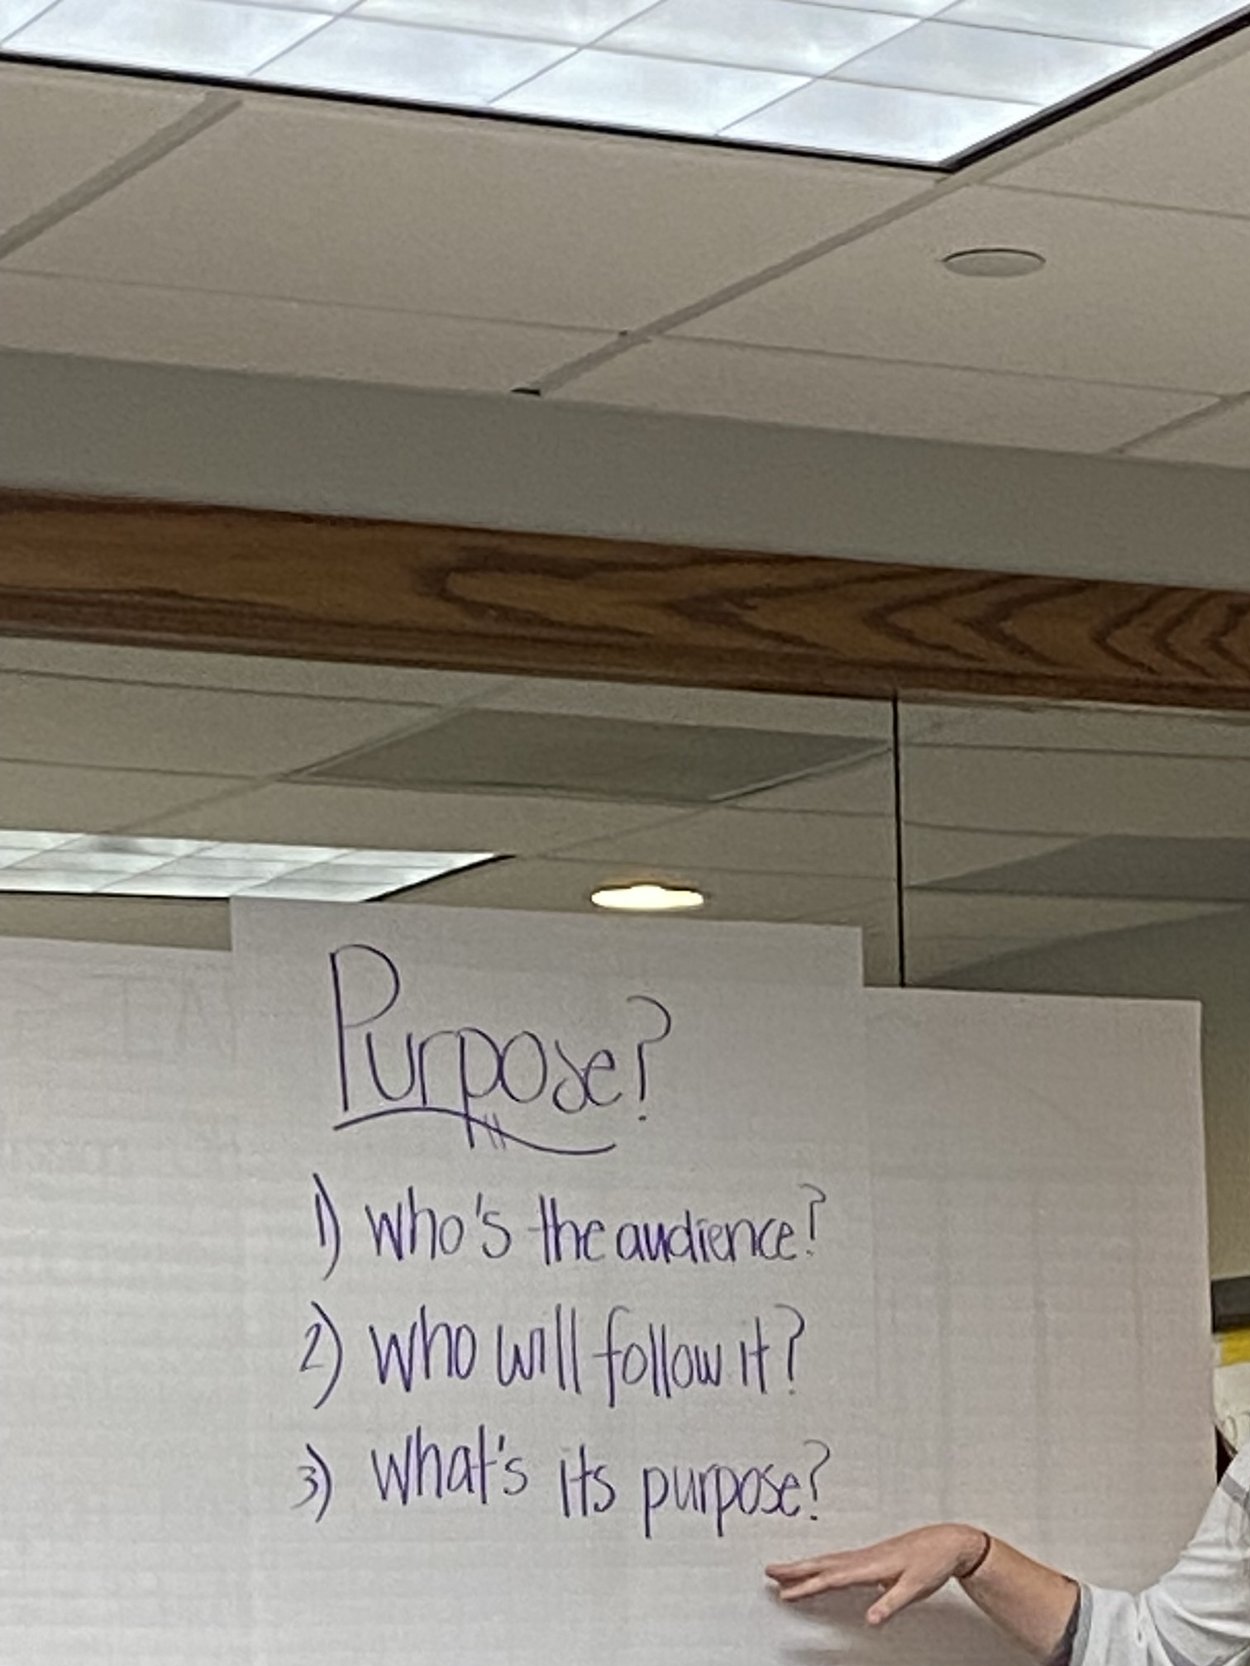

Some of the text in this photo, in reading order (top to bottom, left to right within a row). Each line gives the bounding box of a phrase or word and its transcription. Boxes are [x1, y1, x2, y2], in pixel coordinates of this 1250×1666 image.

[329, 943, 672, 1149] Purpose?
[313, 1173, 341, 1281] 1)
[527, 1193, 606, 1265] the
[616, 1184, 827, 1264] audience?
[299, 1301, 343, 1409] 2)
[498, 1304, 581, 1394] will
[594, 1306, 722, 1408] follow
[740, 1304, 806, 1396] it?
[291, 1443, 333, 1523] 3)
[560, 1445, 616, 1517] its
[644, 1440, 831, 1540] purpose?
